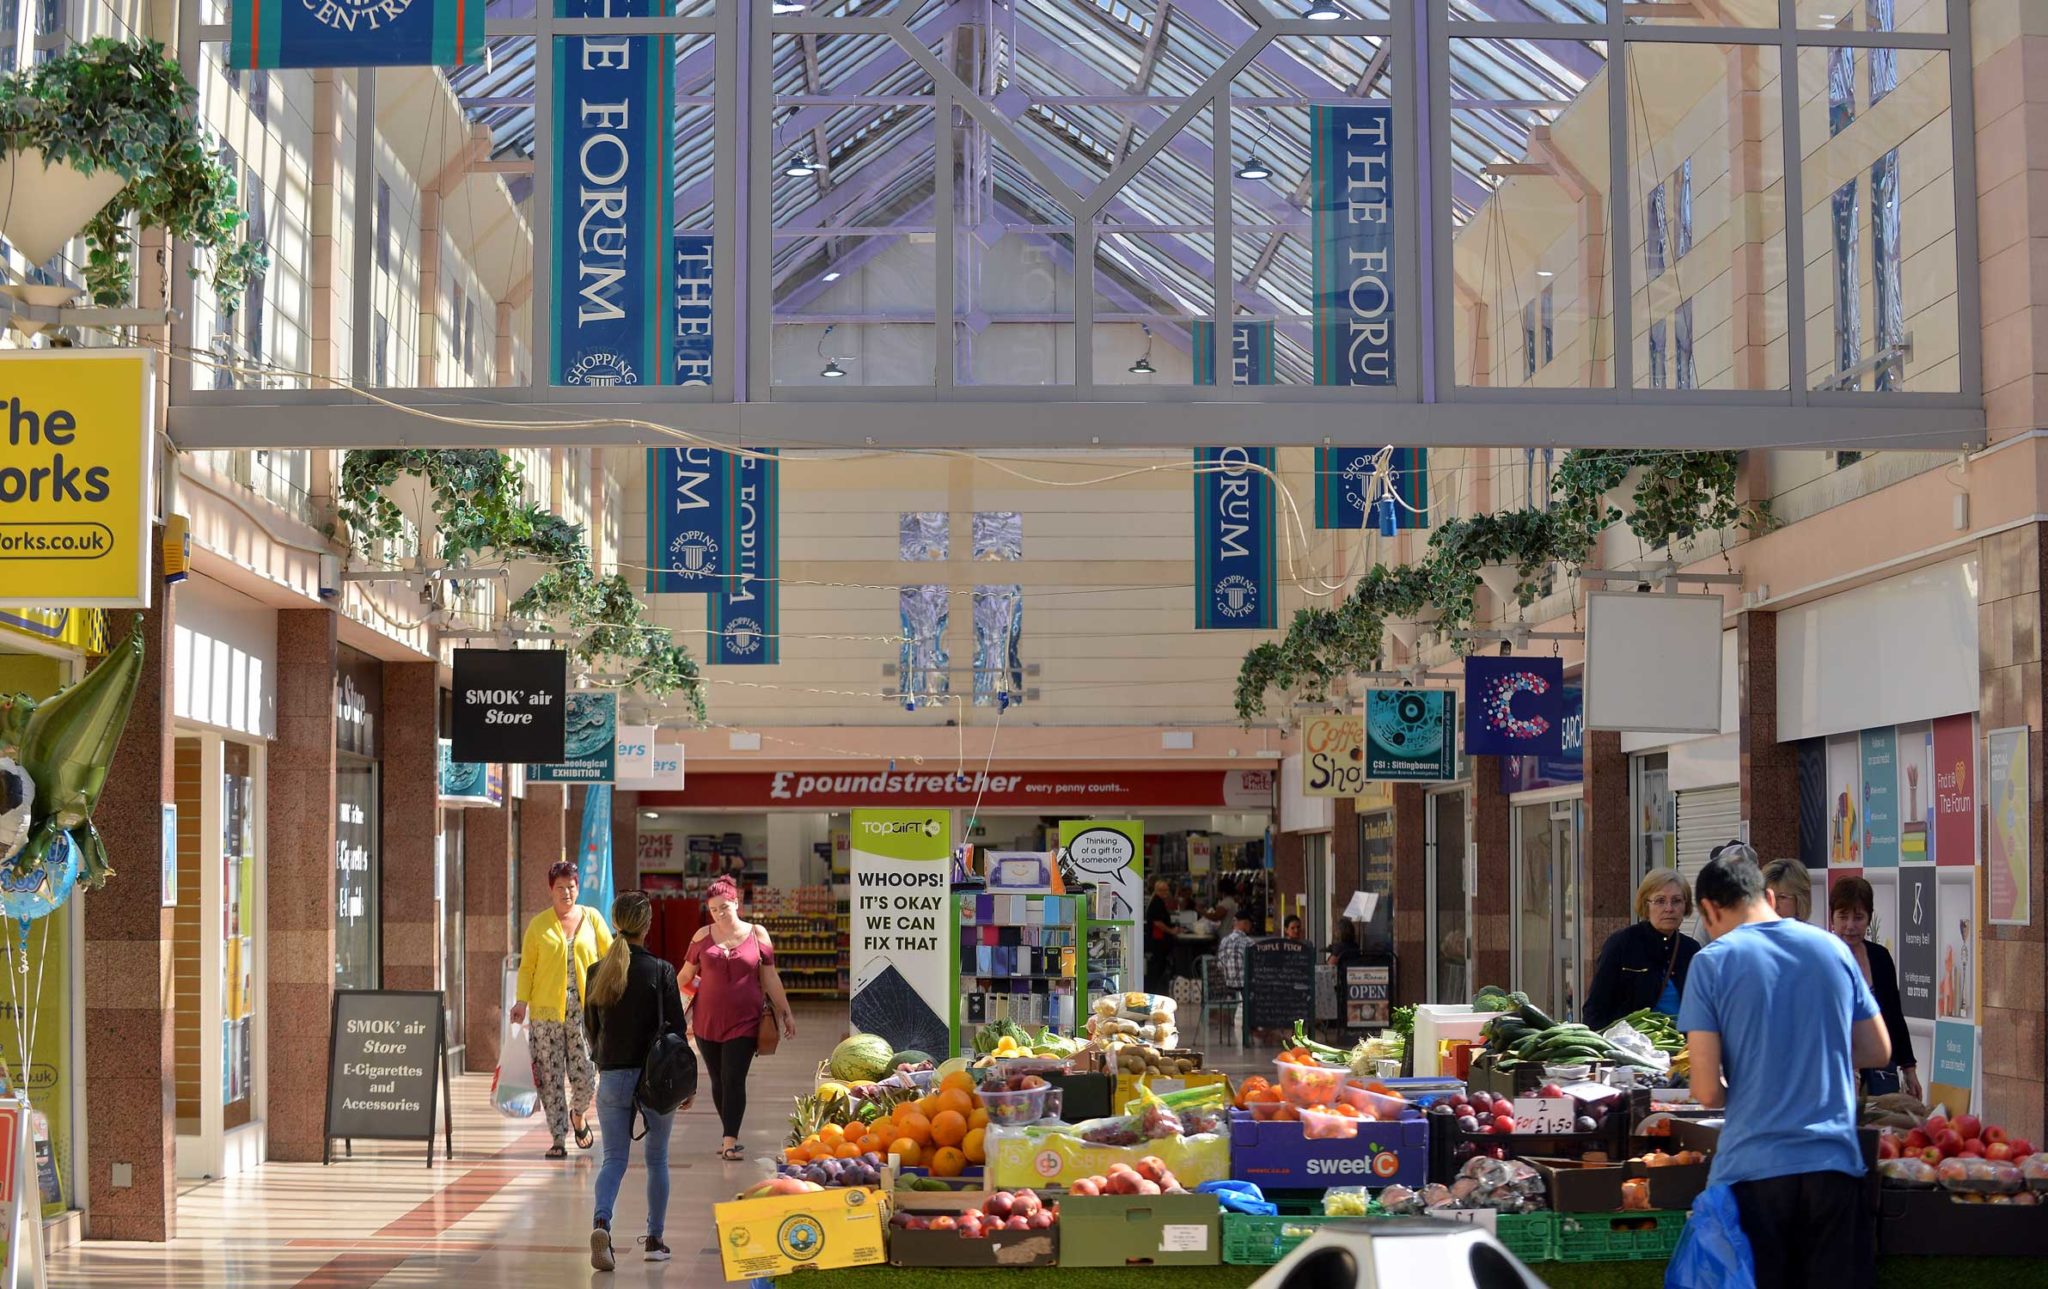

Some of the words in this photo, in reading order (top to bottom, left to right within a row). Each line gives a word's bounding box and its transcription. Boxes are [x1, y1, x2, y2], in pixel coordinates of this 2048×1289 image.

[302, 0, 411, 32] CENTR
[1347, 117, 1388, 224] THE
[578, 97, 629, 329] FORUM
[677, 245, 713, 337] THE
[1348, 246, 1389, 385] FORU
[567, 353, 638, 385] SHOPPING
[0, 397, 76, 446] he
[0, 453, 110, 502] orks
[1219, 447, 1250, 561] ORUM
[0, 531, 104, 551] orks.co.uk
[670, 530, 719, 553] SHOPPING
[1215, 574, 1258, 596] SHOPPING
[1217, 602, 1255, 618] CENTRE
[726, 640, 760, 655] CENTRE
[529, 690, 552, 706] air
[485, 709, 533, 725] Store
[1307, 720, 1363, 753] Coffe
[552, 769, 601, 778] EXHIBITION
[1373, 761, 1386, 769] CSI
[1392, 761, 1440, 771] Sittingbourne
[1025, 783, 1051, 794] every
[1055, 782, 1086, 794] penny
[1940, 794, 1951, 814] The
[1951, 793, 1971, 813] Forum
[639, 834, 673, 846] OME
[1086, 837, 1118, 846] Thinking
[1081, 846, 1089, 854] of
[1098, 847, 1111, 855] gift
[858, 872, 944, 887] WHOOPS!
[860, 896, 889, 910] IT'S
[893, 896, 943, 910] OKAY
[866, 916, 891, 929] WE
[897, 916, 935, 930] CAN
[864, 936, 890, 950] FIX
[895, 937, 938, 950] THAT
[1350, 985, 1387, 999] OPEN
[404, 1020, 426, 1035] air
[363, 1040, 407, 1054] Store
[343, 1063, 423, 1079] E-Cigarettes
[369, 1081, 395, 1093] and
[342, 1097, 420, 1112] Accessories
[1538, 1099, 1549, 1112] 2
